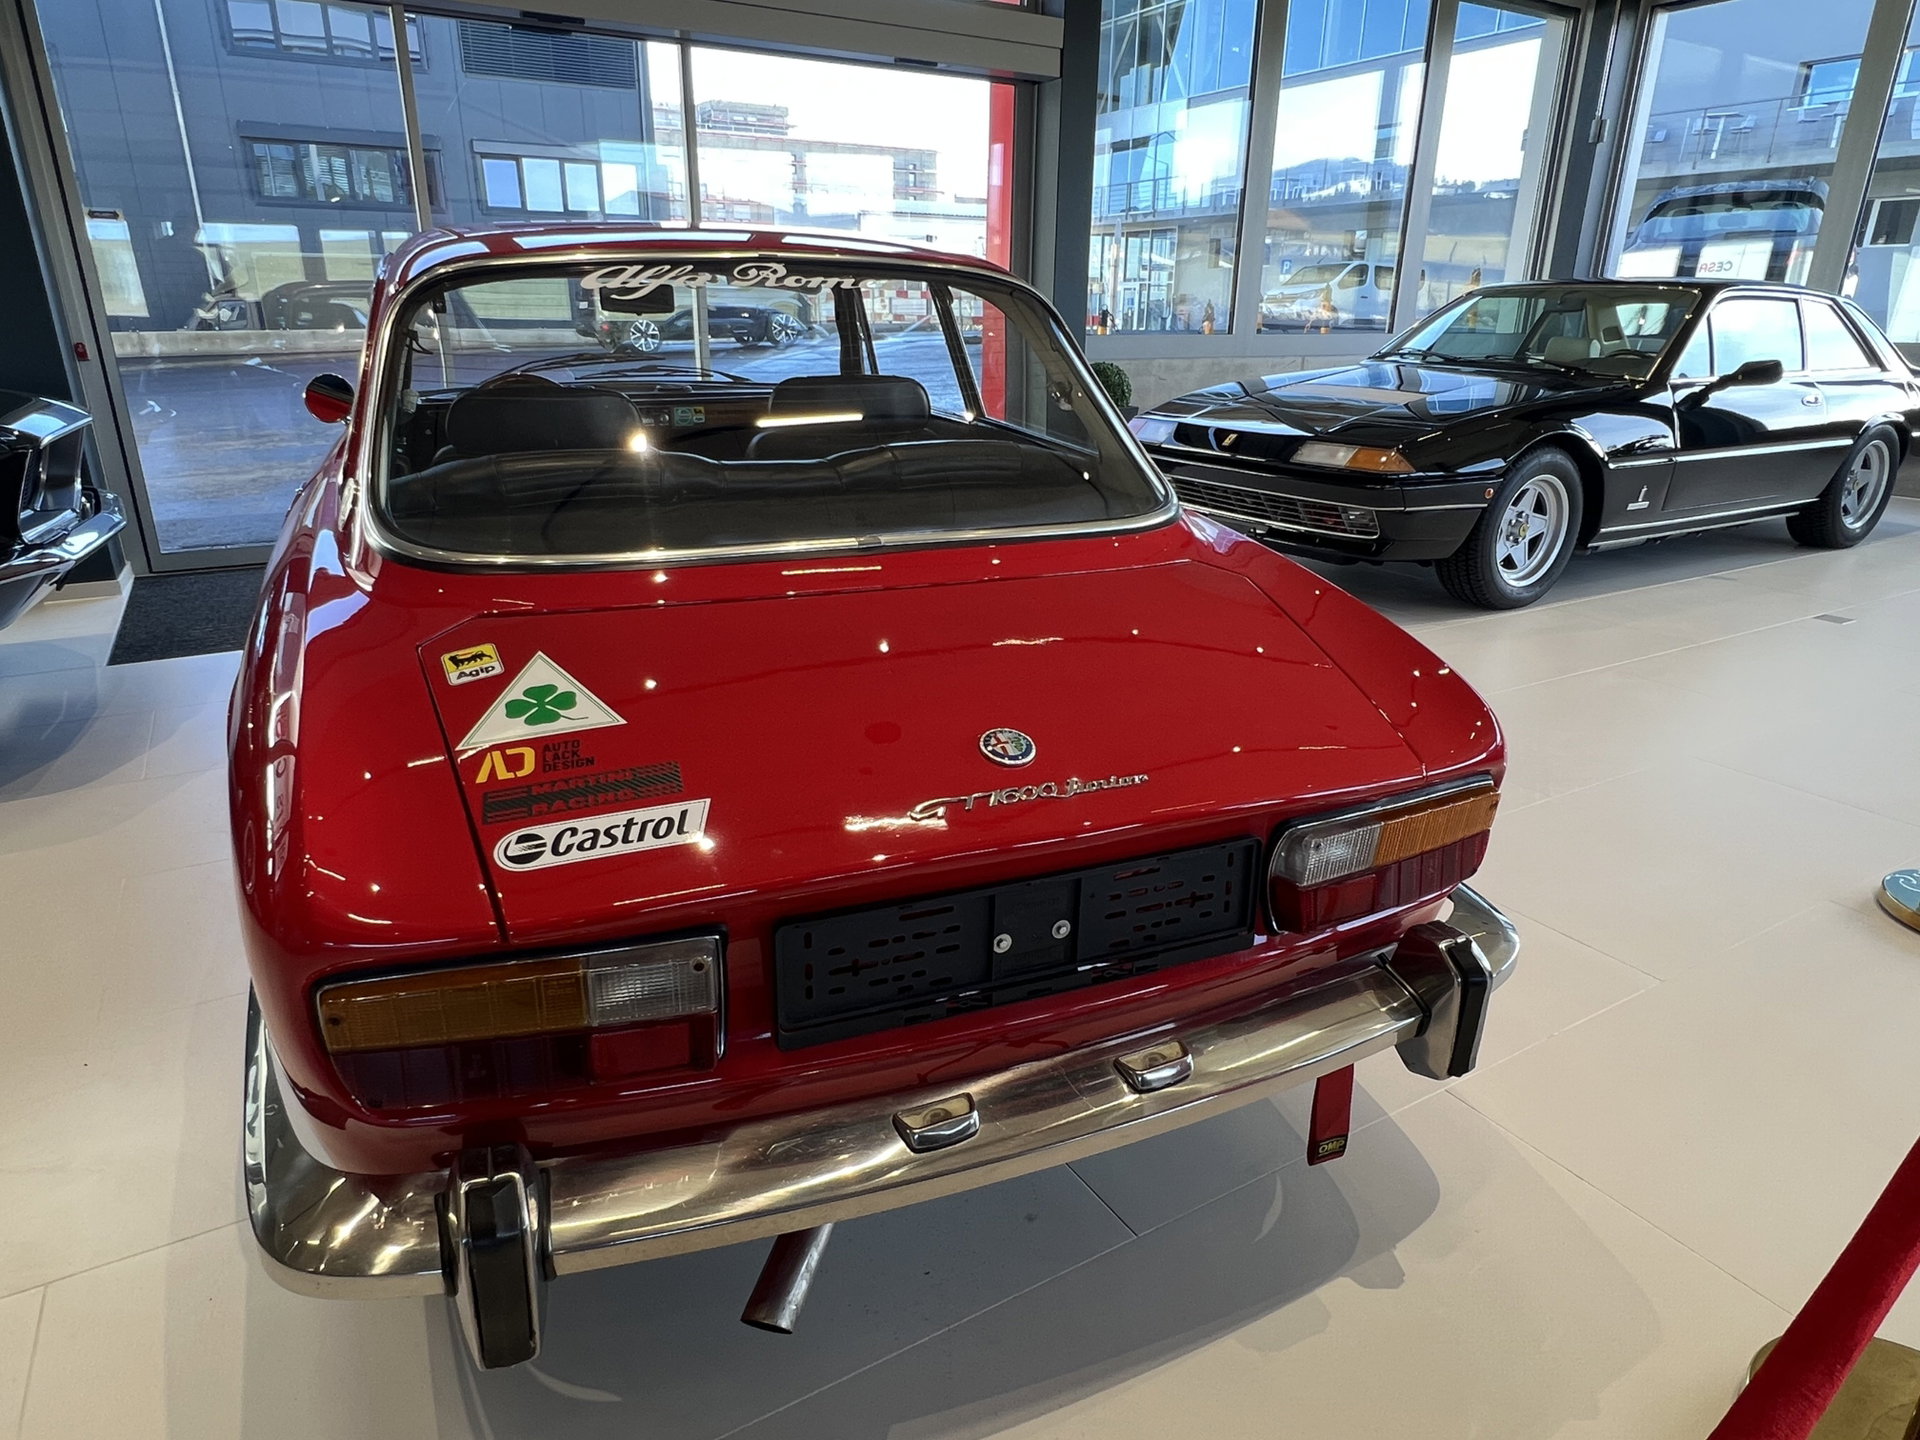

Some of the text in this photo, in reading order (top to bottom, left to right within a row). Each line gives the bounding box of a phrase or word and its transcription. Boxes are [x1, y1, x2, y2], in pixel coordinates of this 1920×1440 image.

[580, 264, 717, 300] Alfa
[457, 665, 496, 680] Agip
[543, 739, 581, 753] AUTO
[543, 751, 581, 764] LACK
[543, 757, 595, 773] DESIGN
[551, 808, 690, 857] Castrol
[1319, 1140, 1345, 1154] OMP
